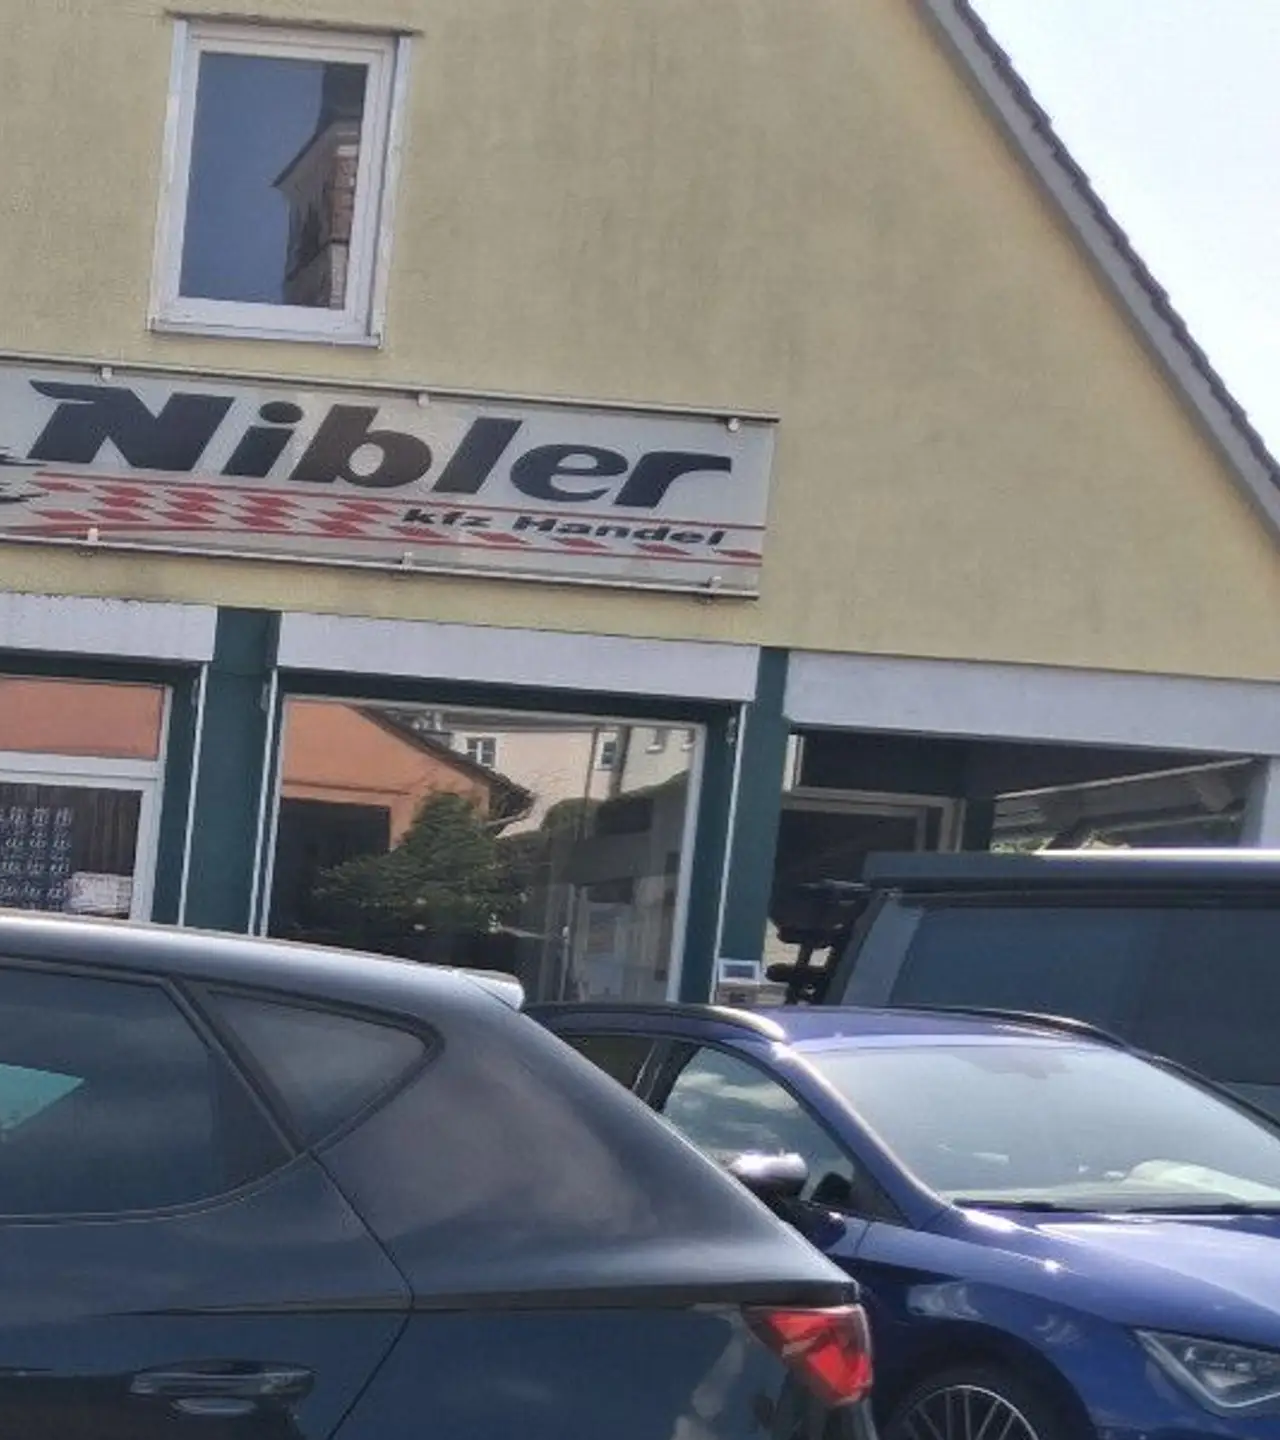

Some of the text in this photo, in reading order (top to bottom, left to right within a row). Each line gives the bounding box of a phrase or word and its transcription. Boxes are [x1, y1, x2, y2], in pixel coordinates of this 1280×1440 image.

[29, 379, 731, 508] Nibler
[403, 508, 725, 546] kfz Handel
